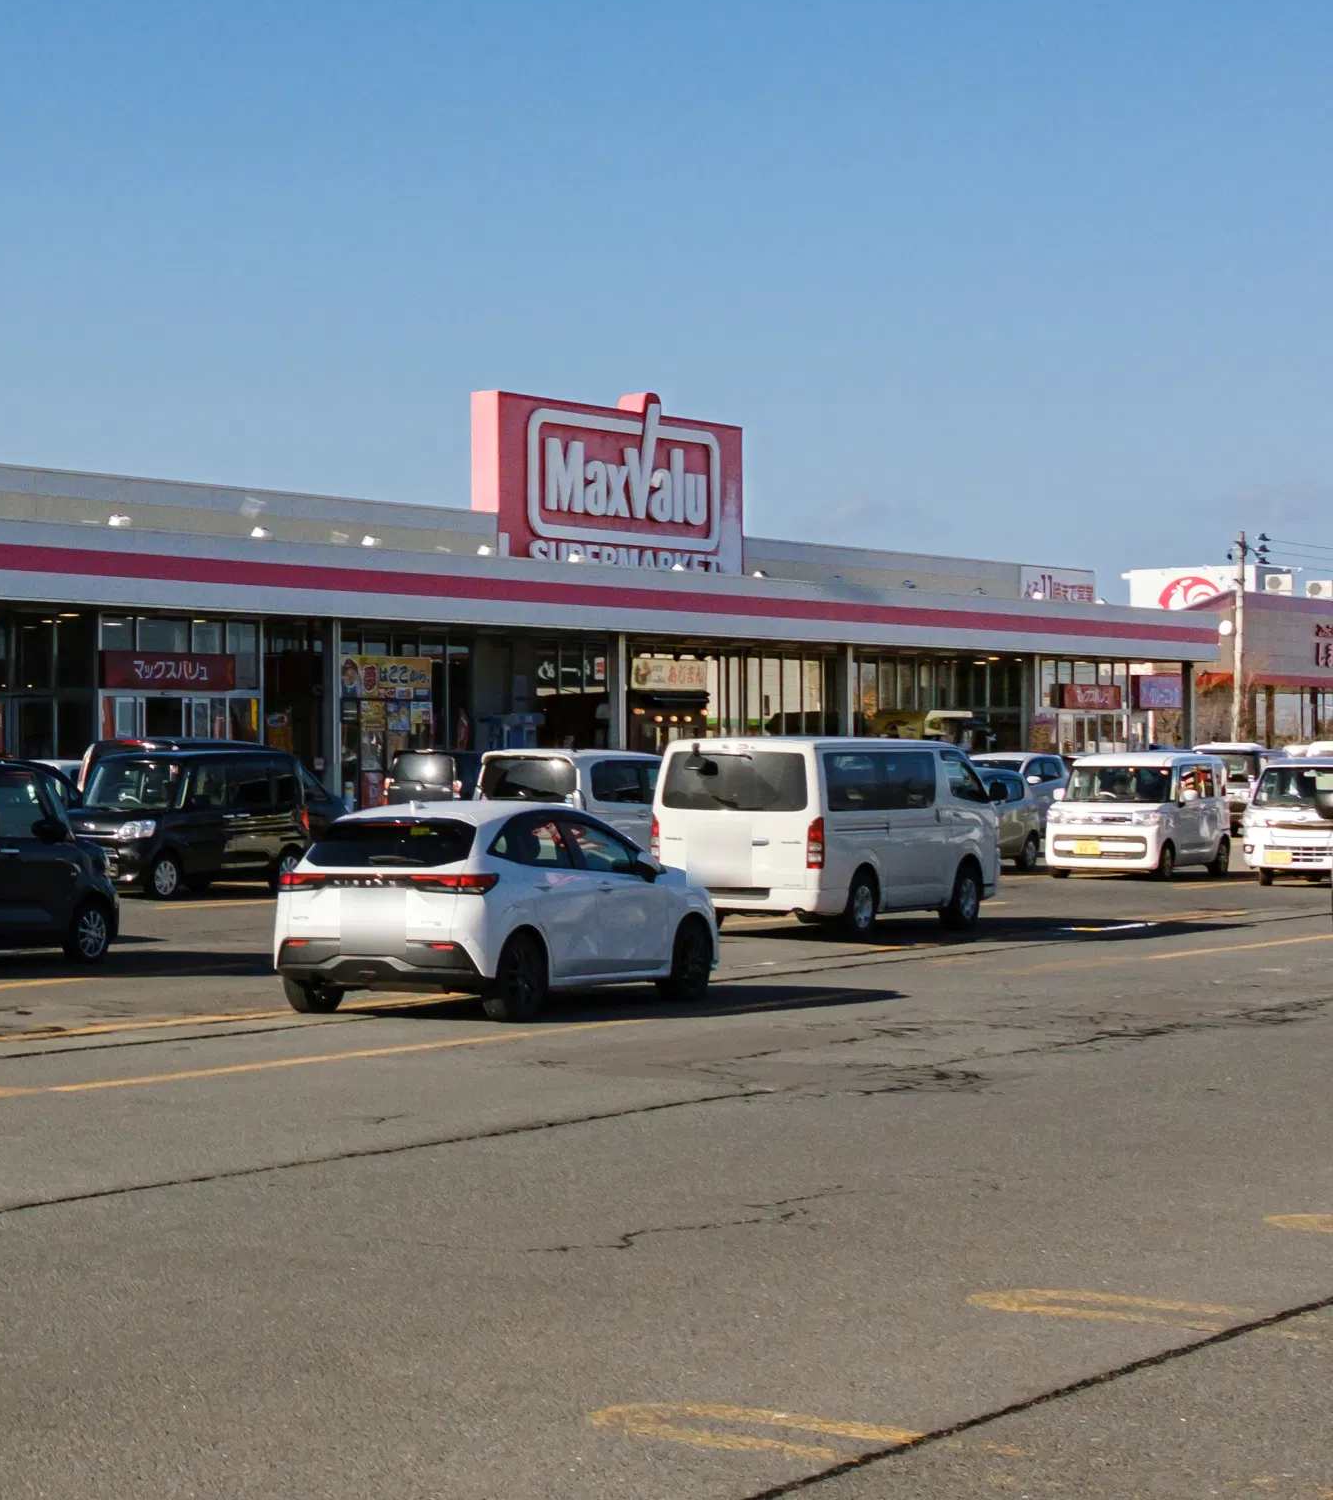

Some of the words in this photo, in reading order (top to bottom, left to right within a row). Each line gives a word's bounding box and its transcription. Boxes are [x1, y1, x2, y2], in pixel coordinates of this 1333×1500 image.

[544, 403, 707, 526] MaxValu
[133, 660, 209, 681] マックスバリュ
